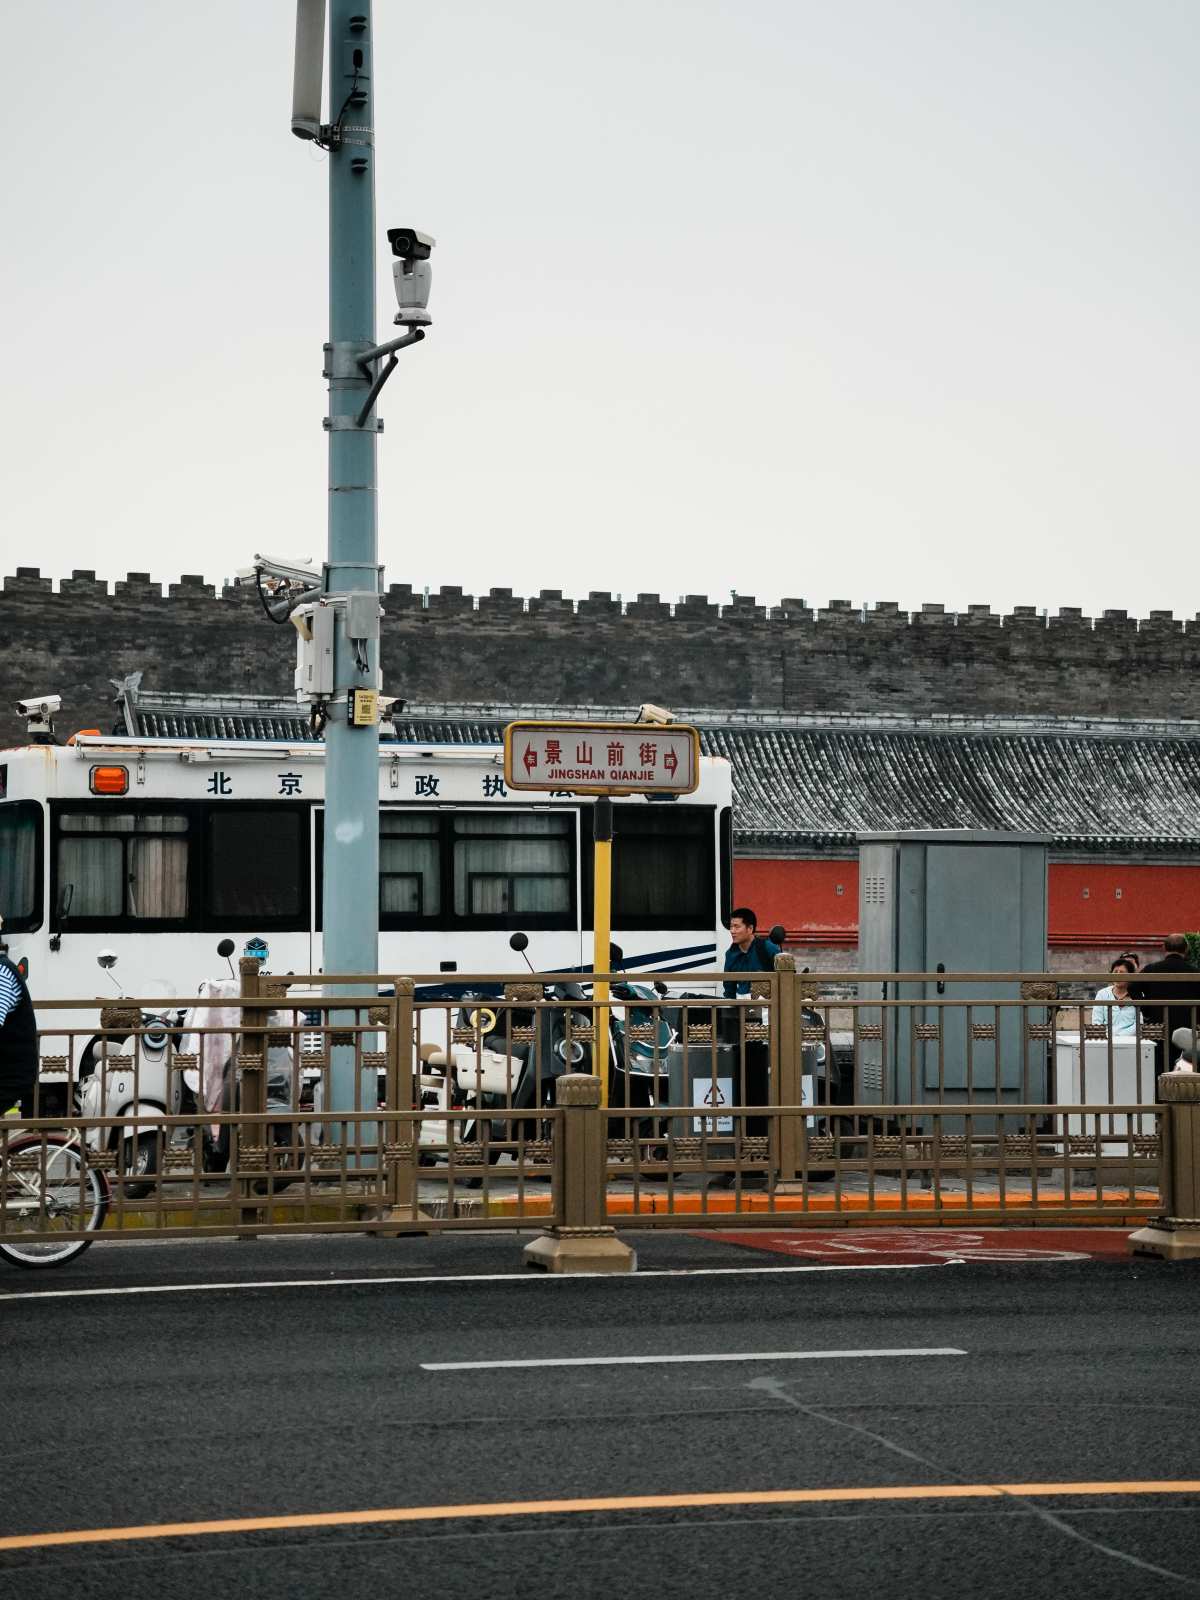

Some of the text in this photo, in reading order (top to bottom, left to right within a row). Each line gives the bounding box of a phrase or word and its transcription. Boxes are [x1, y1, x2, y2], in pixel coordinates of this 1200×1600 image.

[544, 739, 657, 767] 景山前街
[548, 769, 654, 781] JINGSHAN QIANJIE
